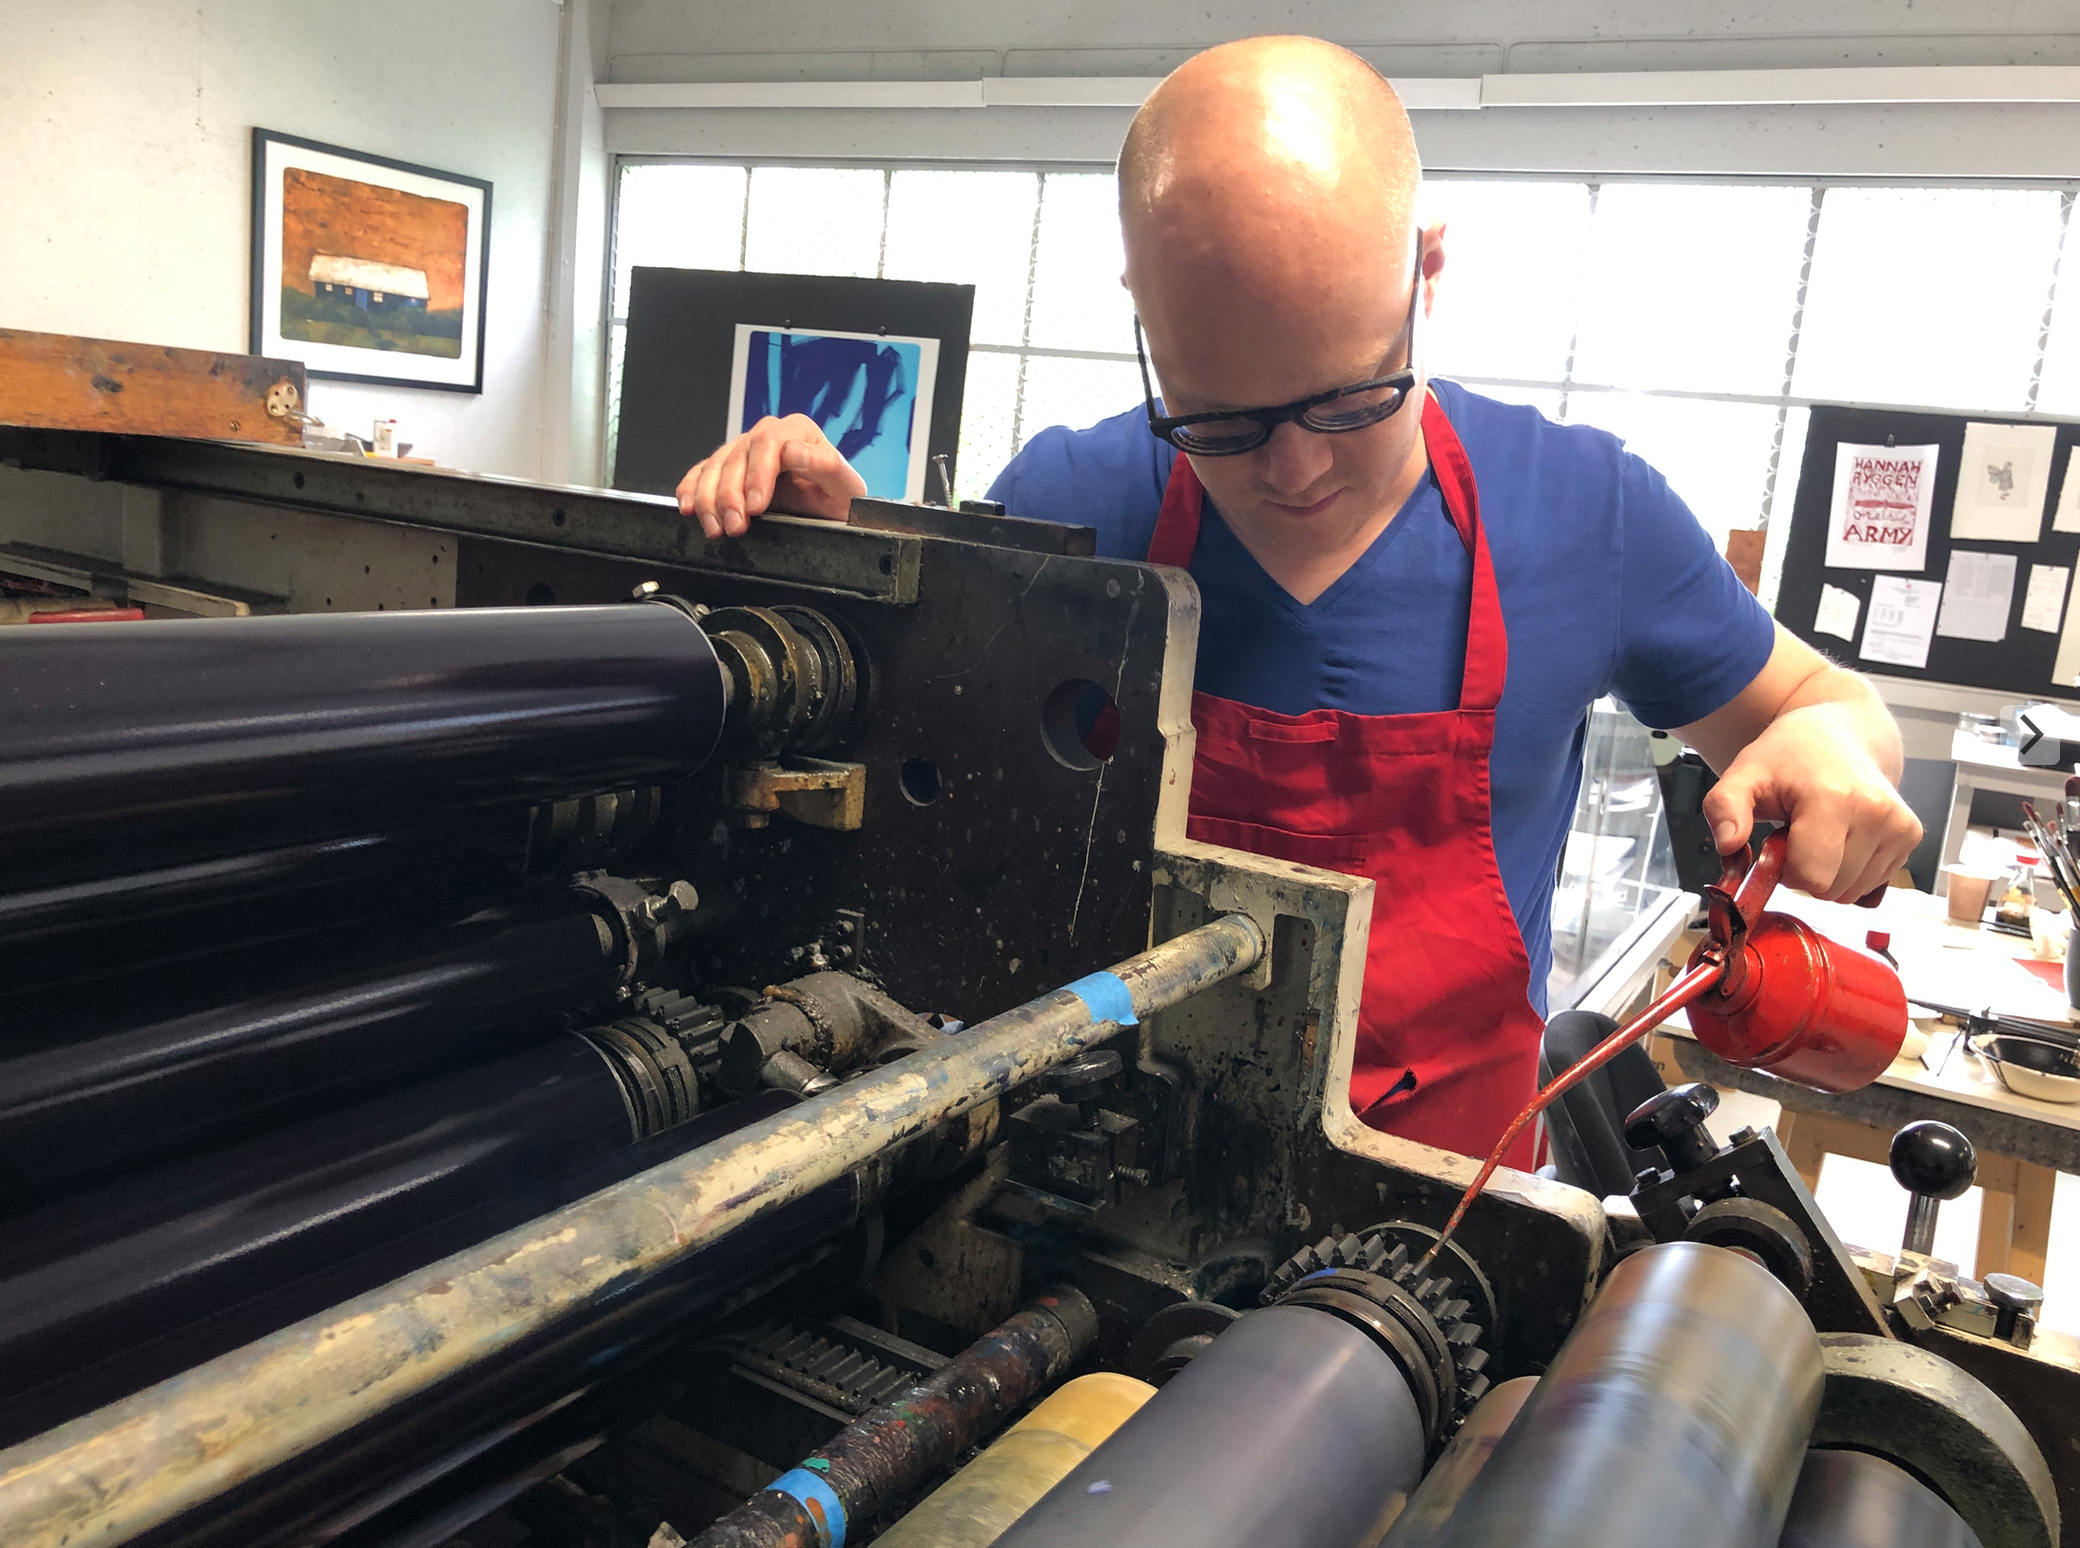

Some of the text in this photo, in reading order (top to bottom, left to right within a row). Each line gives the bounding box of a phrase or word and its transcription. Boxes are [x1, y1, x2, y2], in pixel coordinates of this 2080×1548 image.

[1855, 457, 1921, 473] HANNAH
[1853, 471, 1918, 488] RYGGEN
[1843, 524, 1912, 545] ARMY
